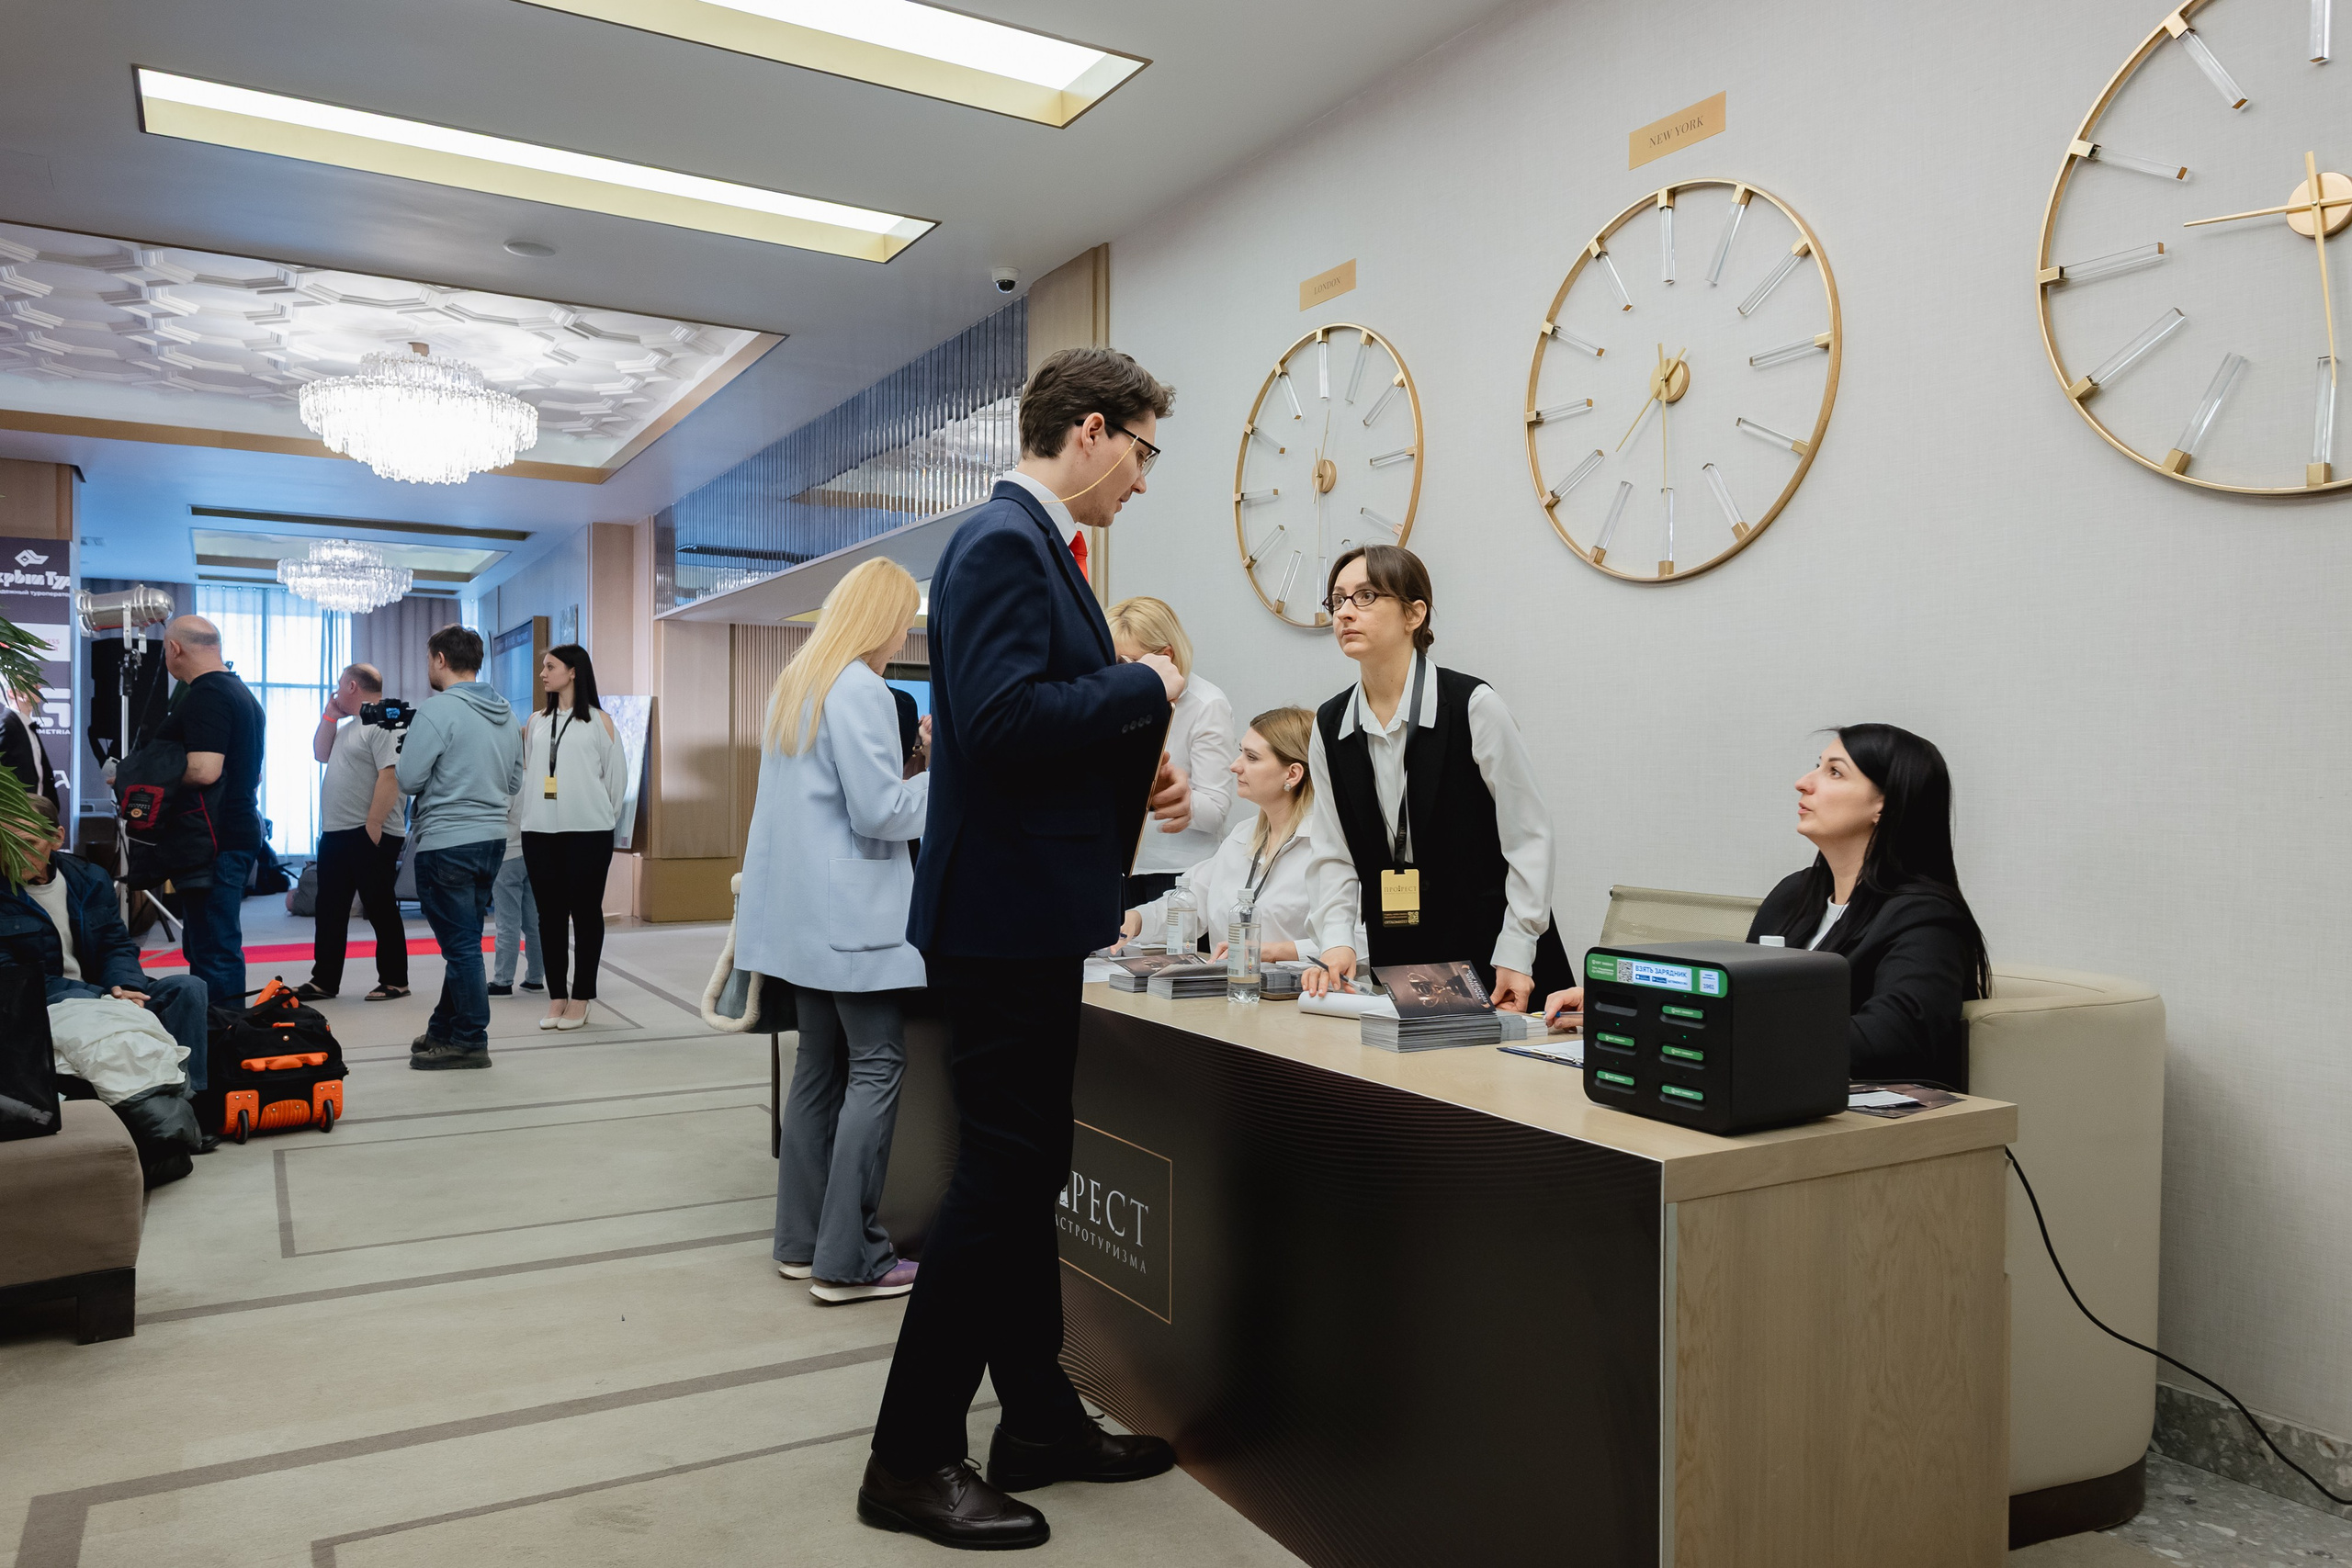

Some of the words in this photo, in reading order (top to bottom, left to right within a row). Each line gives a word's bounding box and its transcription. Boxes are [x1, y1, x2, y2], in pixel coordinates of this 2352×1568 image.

[1649, 129, 1673, 148] NEW
[1675, 115, 1703, 136] YORK
[1313, 276, 1341, 295] LONDON
[1635, 964, 1654, 974] ВЗЯТЬ
[1655, 967, 1688, 978] ЗАРЯДНИК
